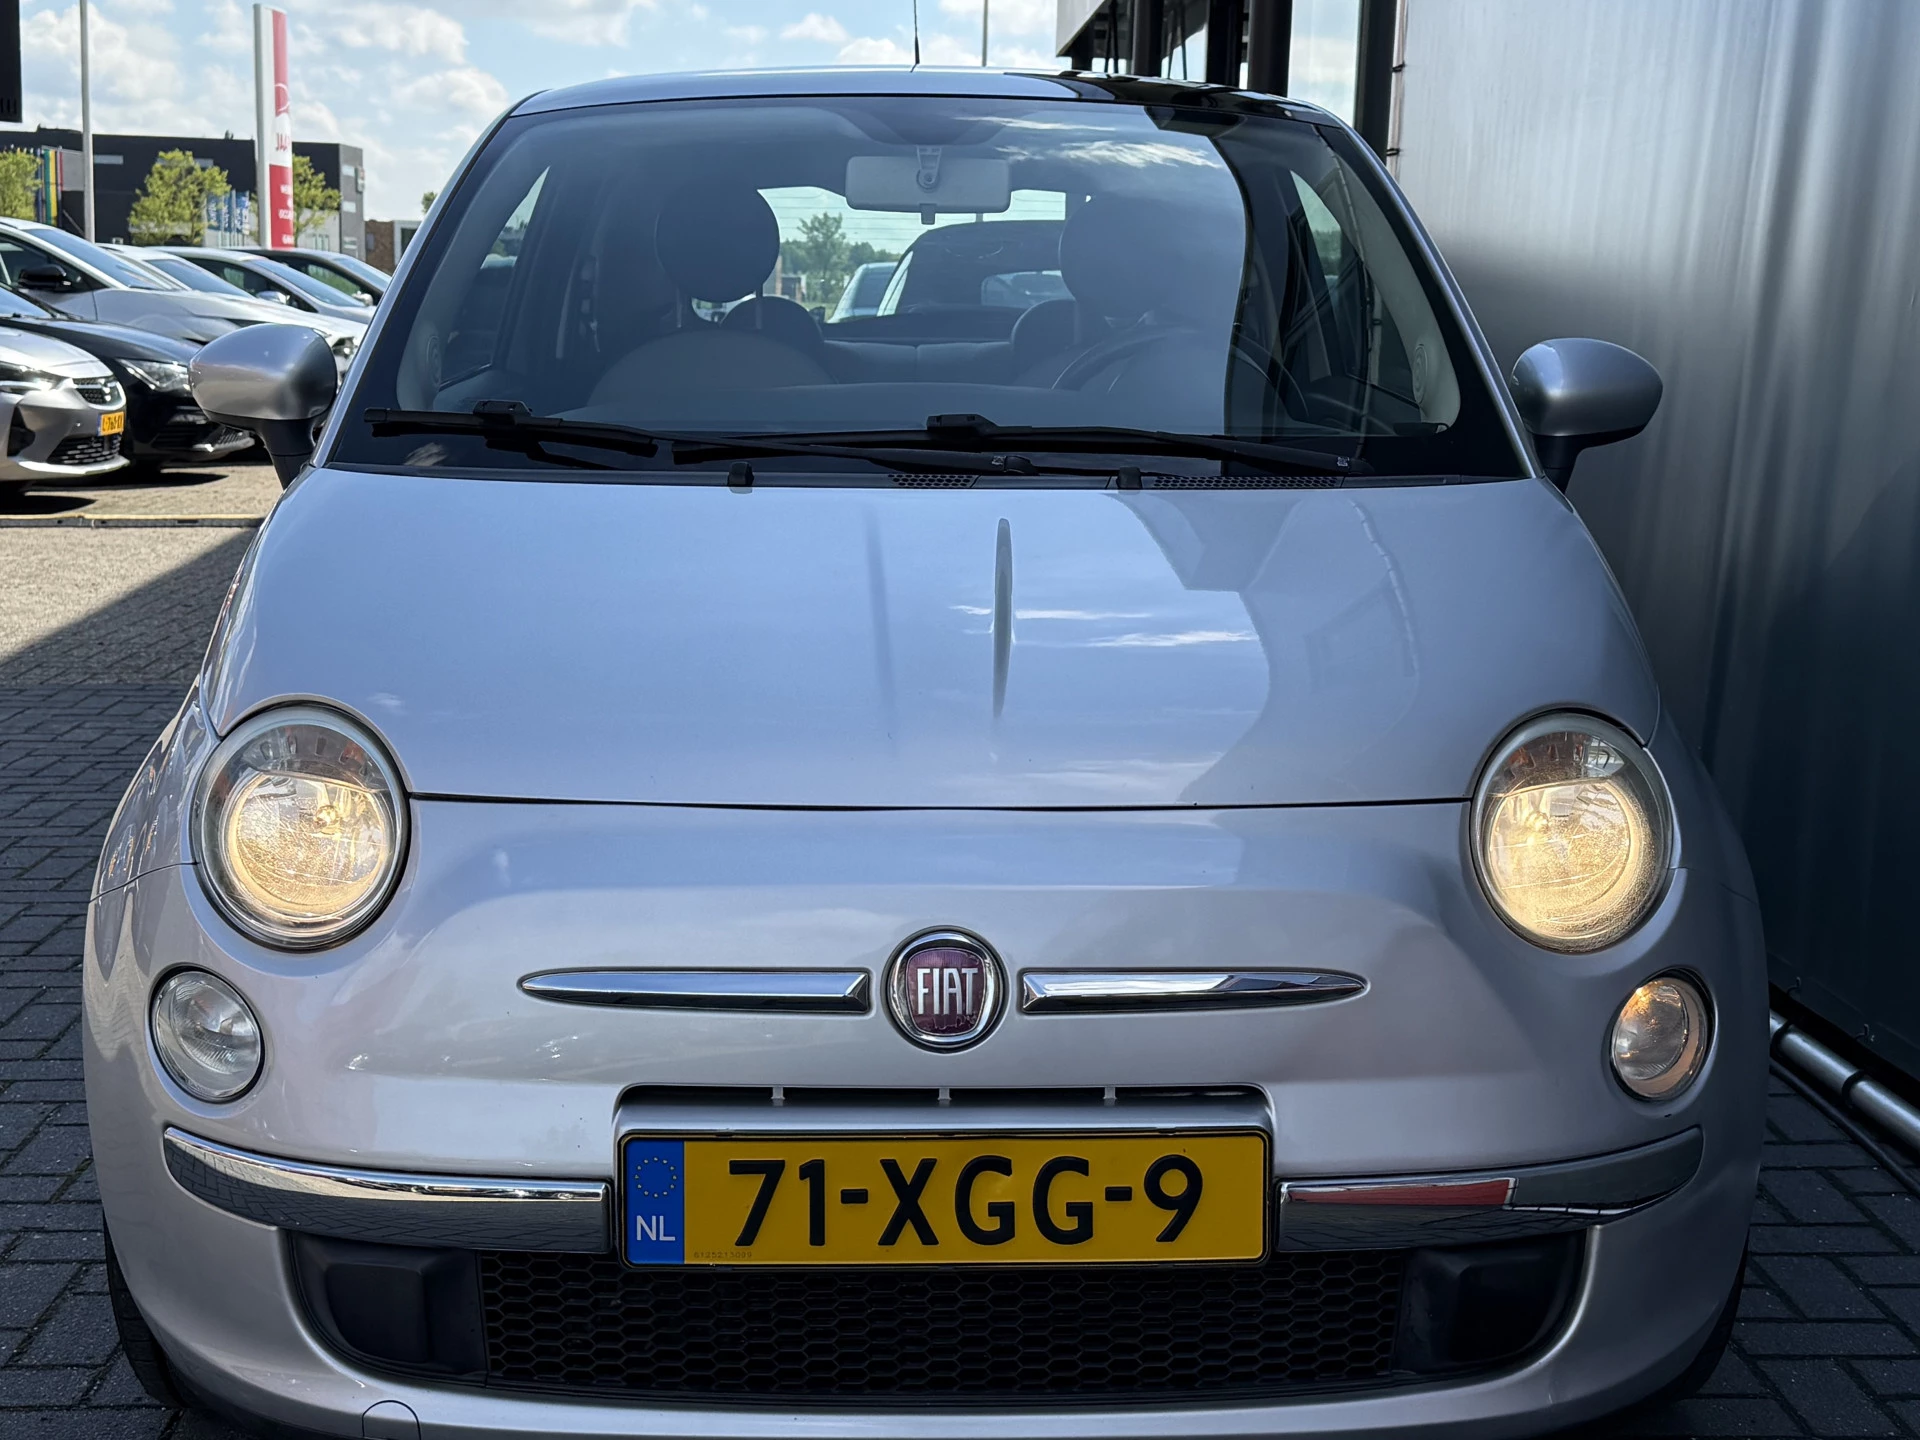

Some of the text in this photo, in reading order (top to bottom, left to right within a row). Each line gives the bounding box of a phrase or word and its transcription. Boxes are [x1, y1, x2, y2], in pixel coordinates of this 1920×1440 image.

[917, 968, 979, 1015] FIAT
[728, 1154, 1204, 1247] 71-XGG-9
[636, 1215, 676, 1242] NL
